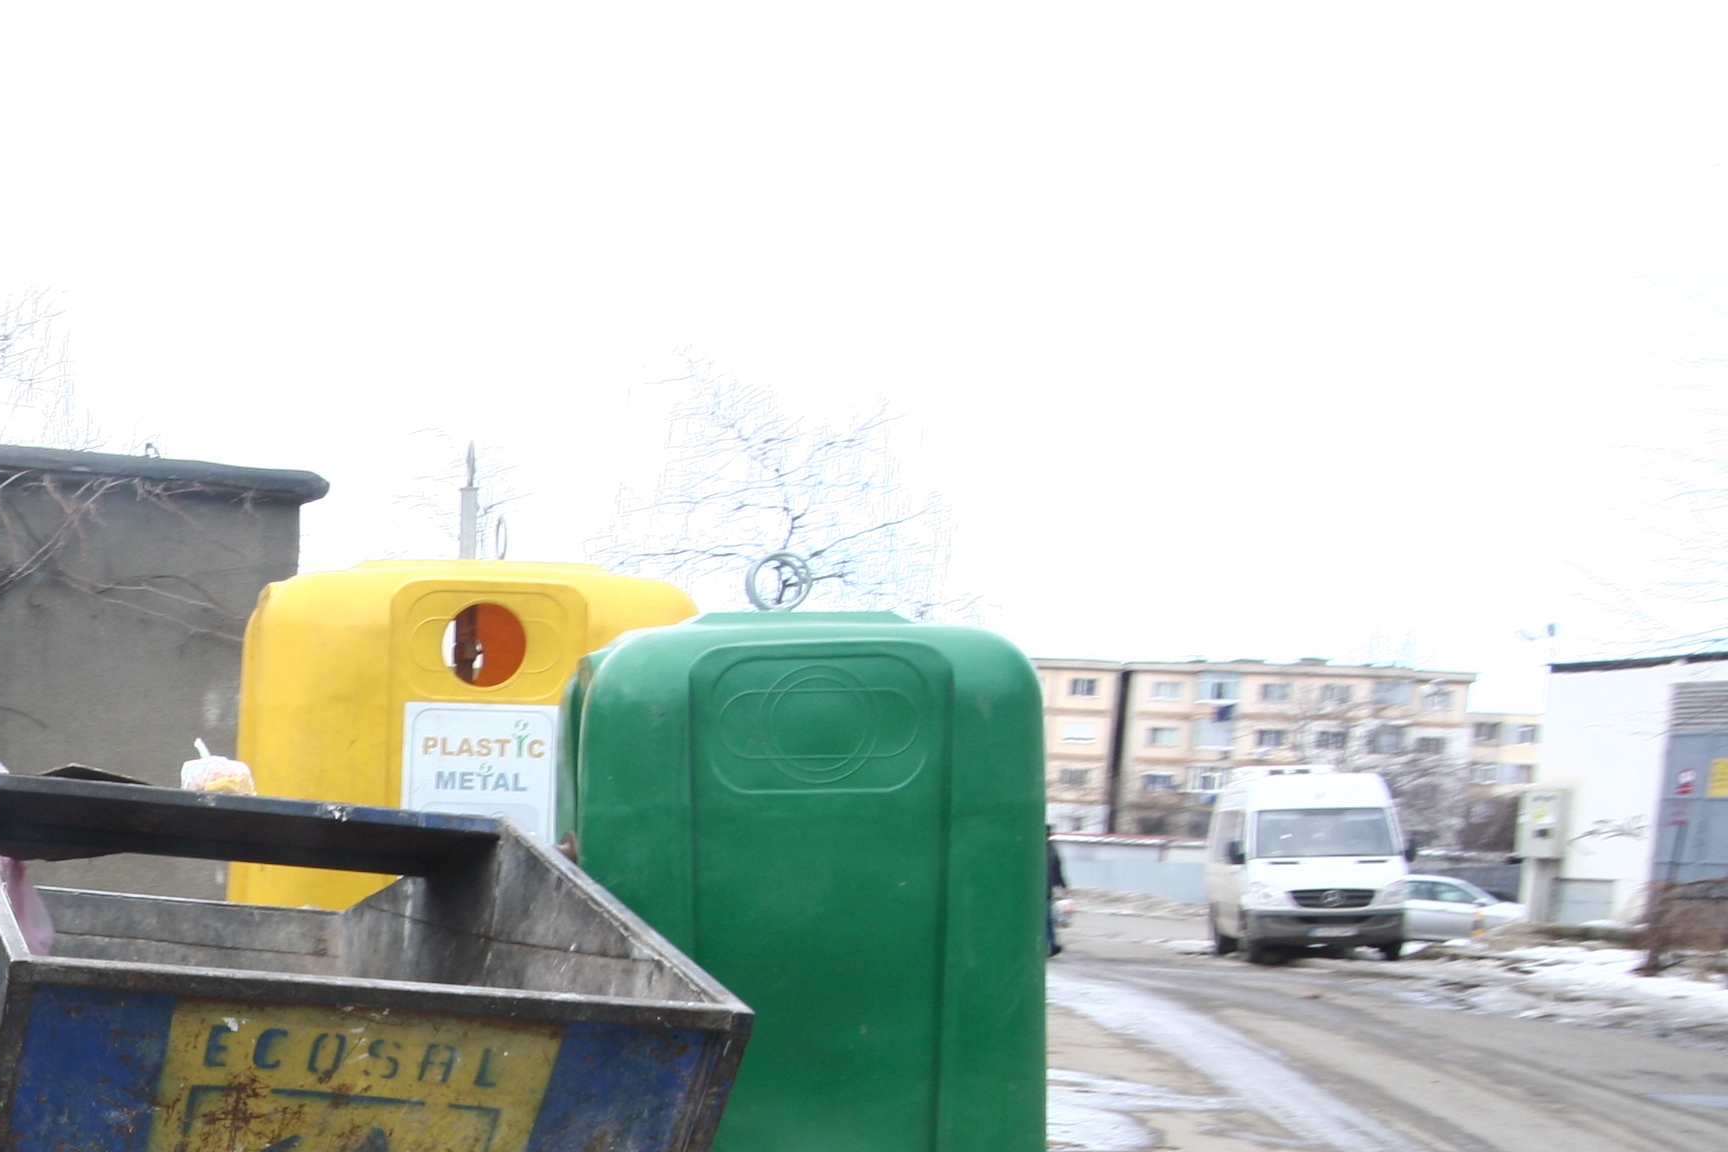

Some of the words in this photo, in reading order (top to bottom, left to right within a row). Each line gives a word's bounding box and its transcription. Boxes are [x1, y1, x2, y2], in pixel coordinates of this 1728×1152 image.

[422, 732, 547, 760] PLASTIC
[434, 769, 528, 792] METAL
[202, 1023, 498, 1089] ECOSAL
